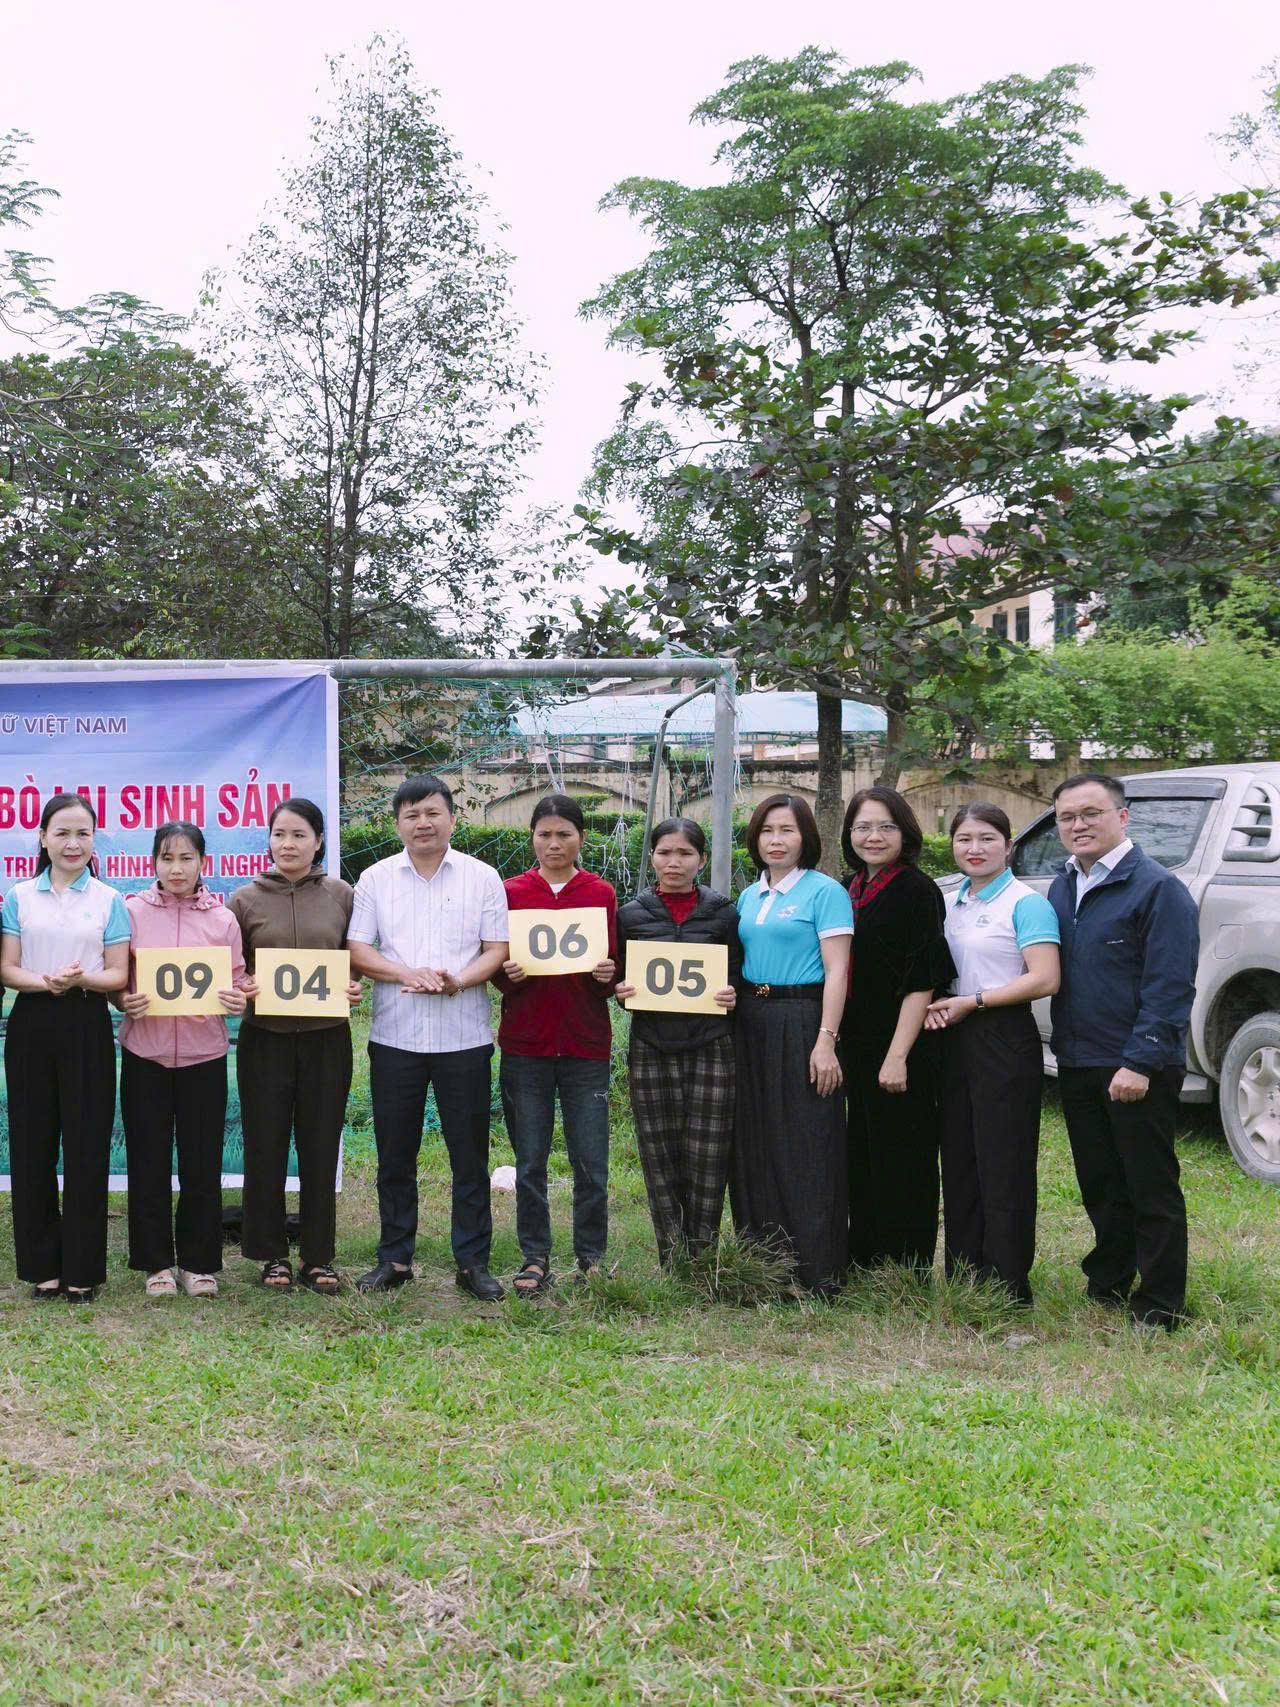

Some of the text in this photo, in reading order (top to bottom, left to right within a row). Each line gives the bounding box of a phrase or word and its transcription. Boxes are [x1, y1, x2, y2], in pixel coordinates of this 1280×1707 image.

[24, 715, 68, 737] VIỆT
[77, 717, 127, 733] NAM
[120, 785, 205, 829] SINH
[528, 923, 588, 960] 06
[156, 962, 213, 1000] 09
[274, 963, 330, 1000] 04
[646, 957, 706, 998] 05
